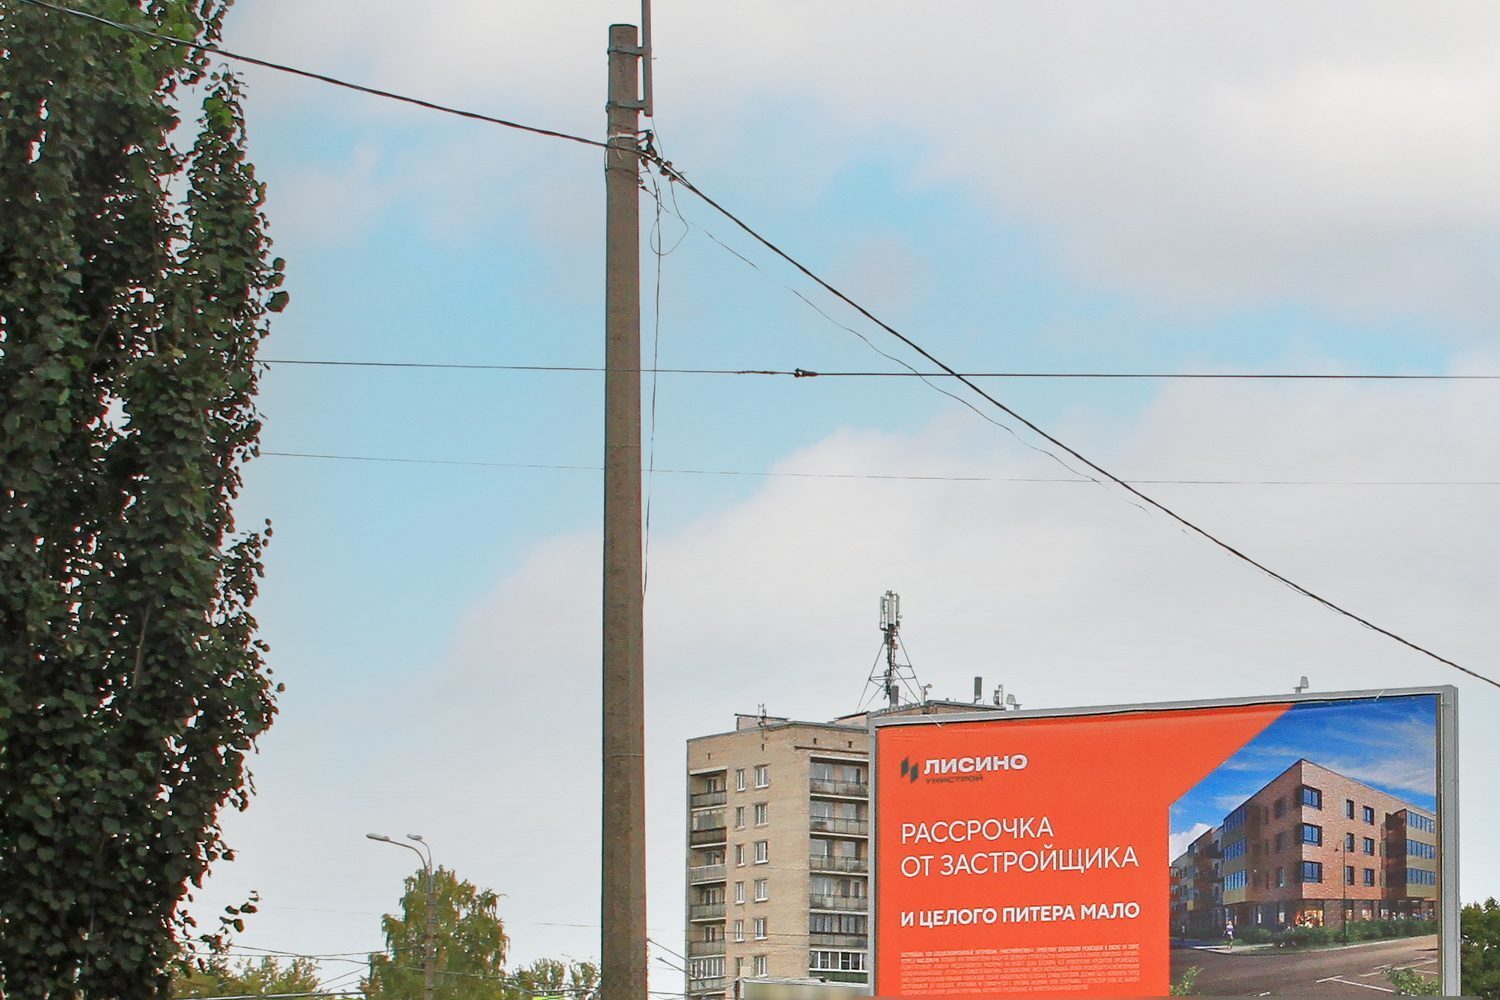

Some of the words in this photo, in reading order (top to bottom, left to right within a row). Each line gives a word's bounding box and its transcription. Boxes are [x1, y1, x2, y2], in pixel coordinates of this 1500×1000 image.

[923, 754, 1028, 774] ЛИСИНО
[901, 816, 1055, 845] РАССРОЧКА
[900, 855, 935, 878] ОТ
[939, 843, 1140, 877] ЗАСТРОЙЩИКА
[900, 911, 914, 927] И
[919, 907, 998, 929] ЦЕЛОГО
[1002, 905, 1076, 924] ПИТЕРА
[1080, 901, 1141, 921] МАЛО
